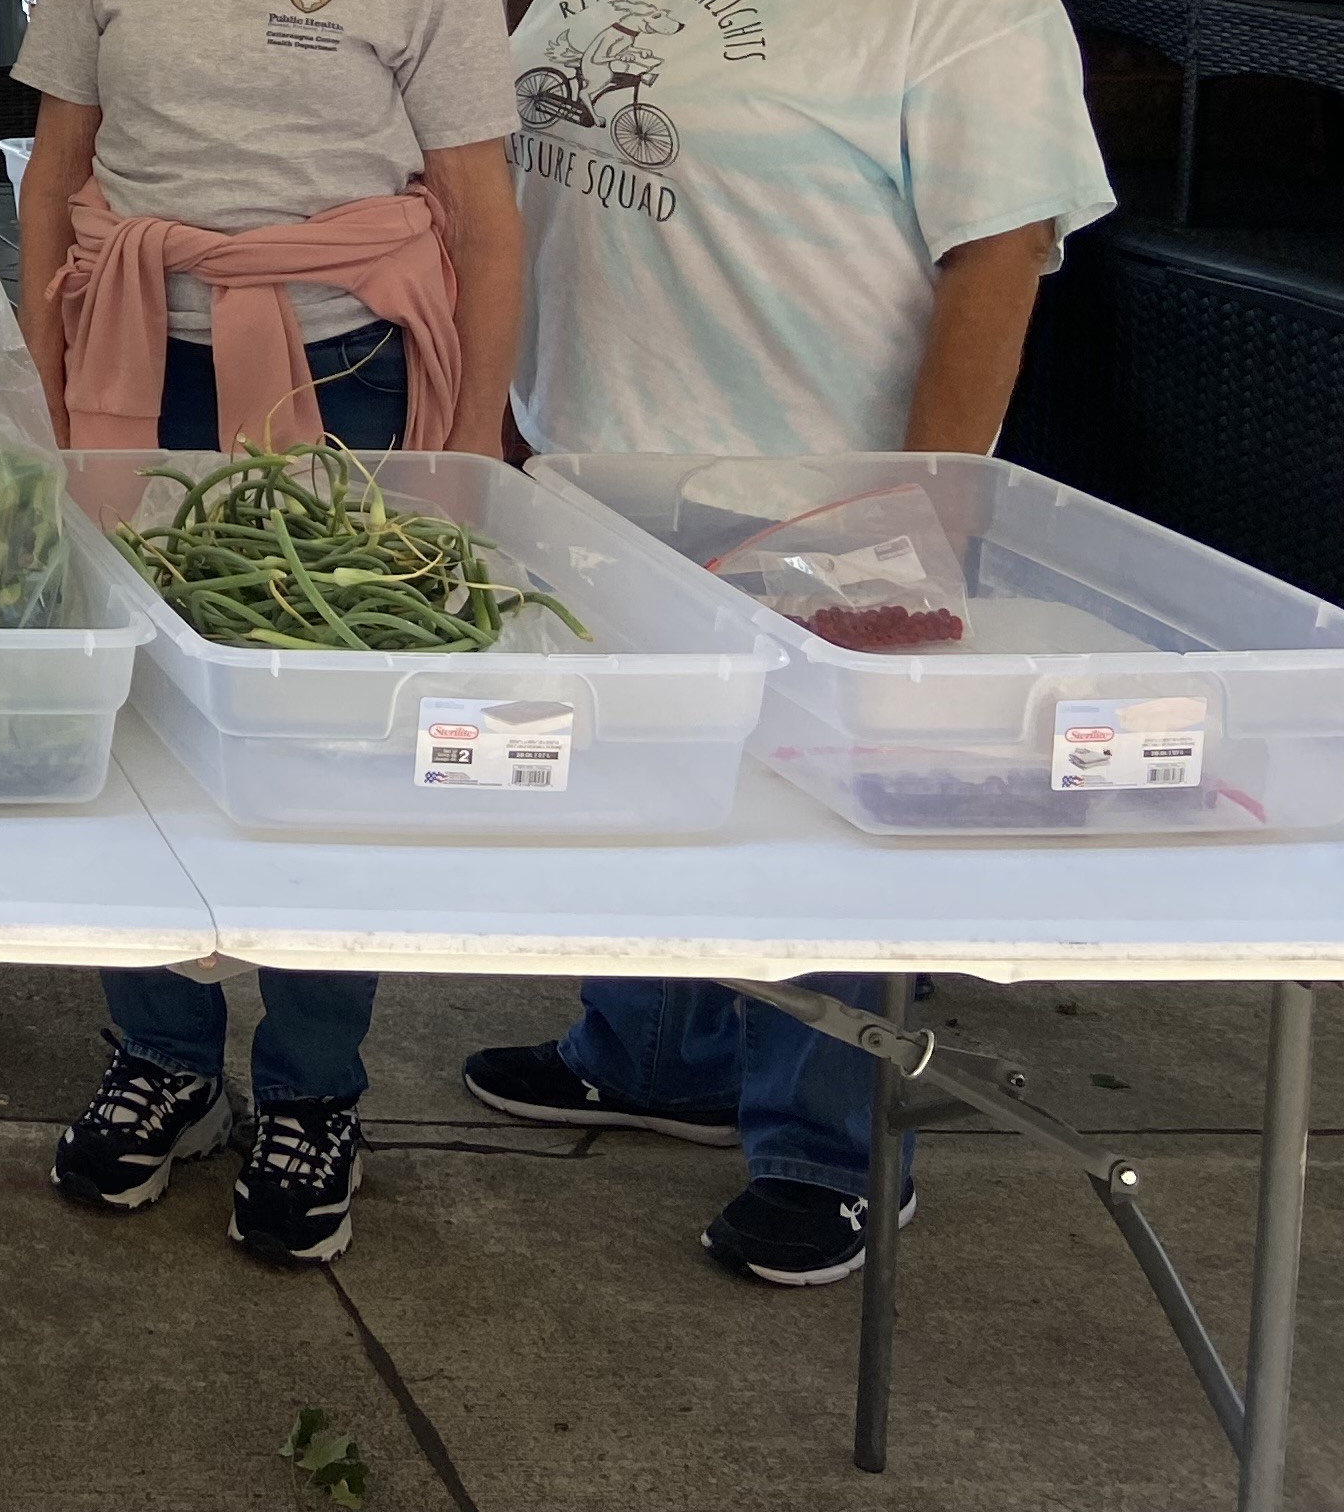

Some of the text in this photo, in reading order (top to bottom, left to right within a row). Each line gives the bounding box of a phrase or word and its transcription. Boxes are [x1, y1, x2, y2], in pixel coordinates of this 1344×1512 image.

[503, 131, 678, 223] LEISURE SQUAD
[458, 749, 470, 763] 2
